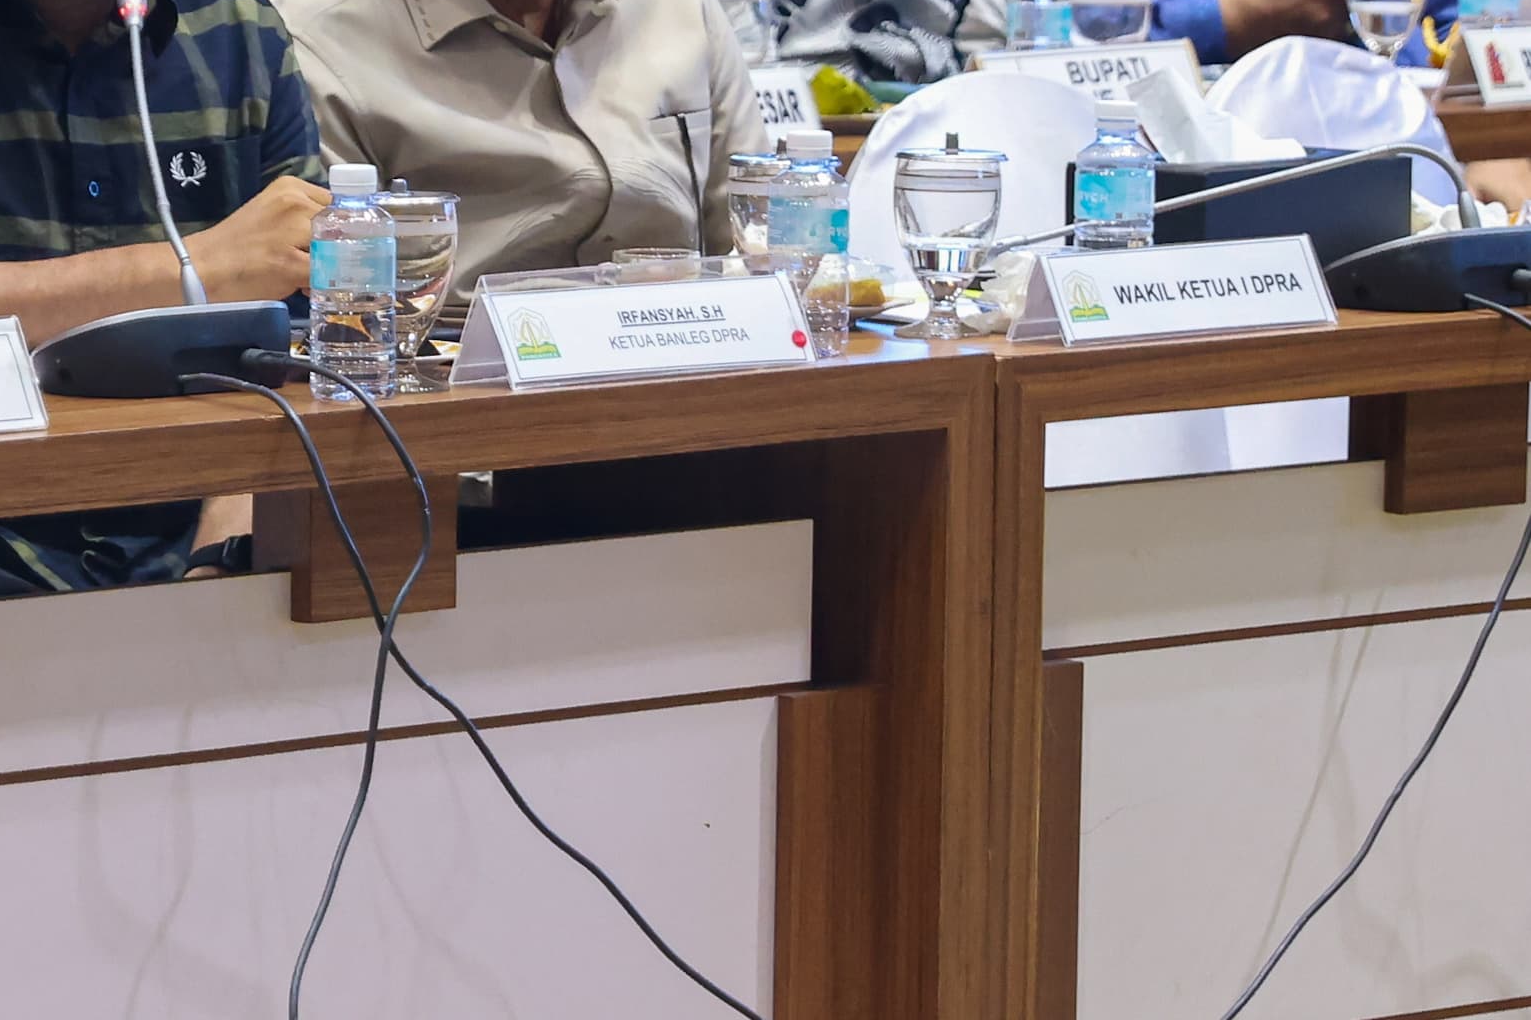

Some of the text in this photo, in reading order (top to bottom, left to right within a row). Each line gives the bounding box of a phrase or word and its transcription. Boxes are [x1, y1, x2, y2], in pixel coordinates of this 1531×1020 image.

[1065, 56, 1150, 84] BUPATI
[1114, 273, 1302, 305] WAKIL KETUA I DPRA
[609, 327, 751, 350] KETUA BANLEG DPRA
